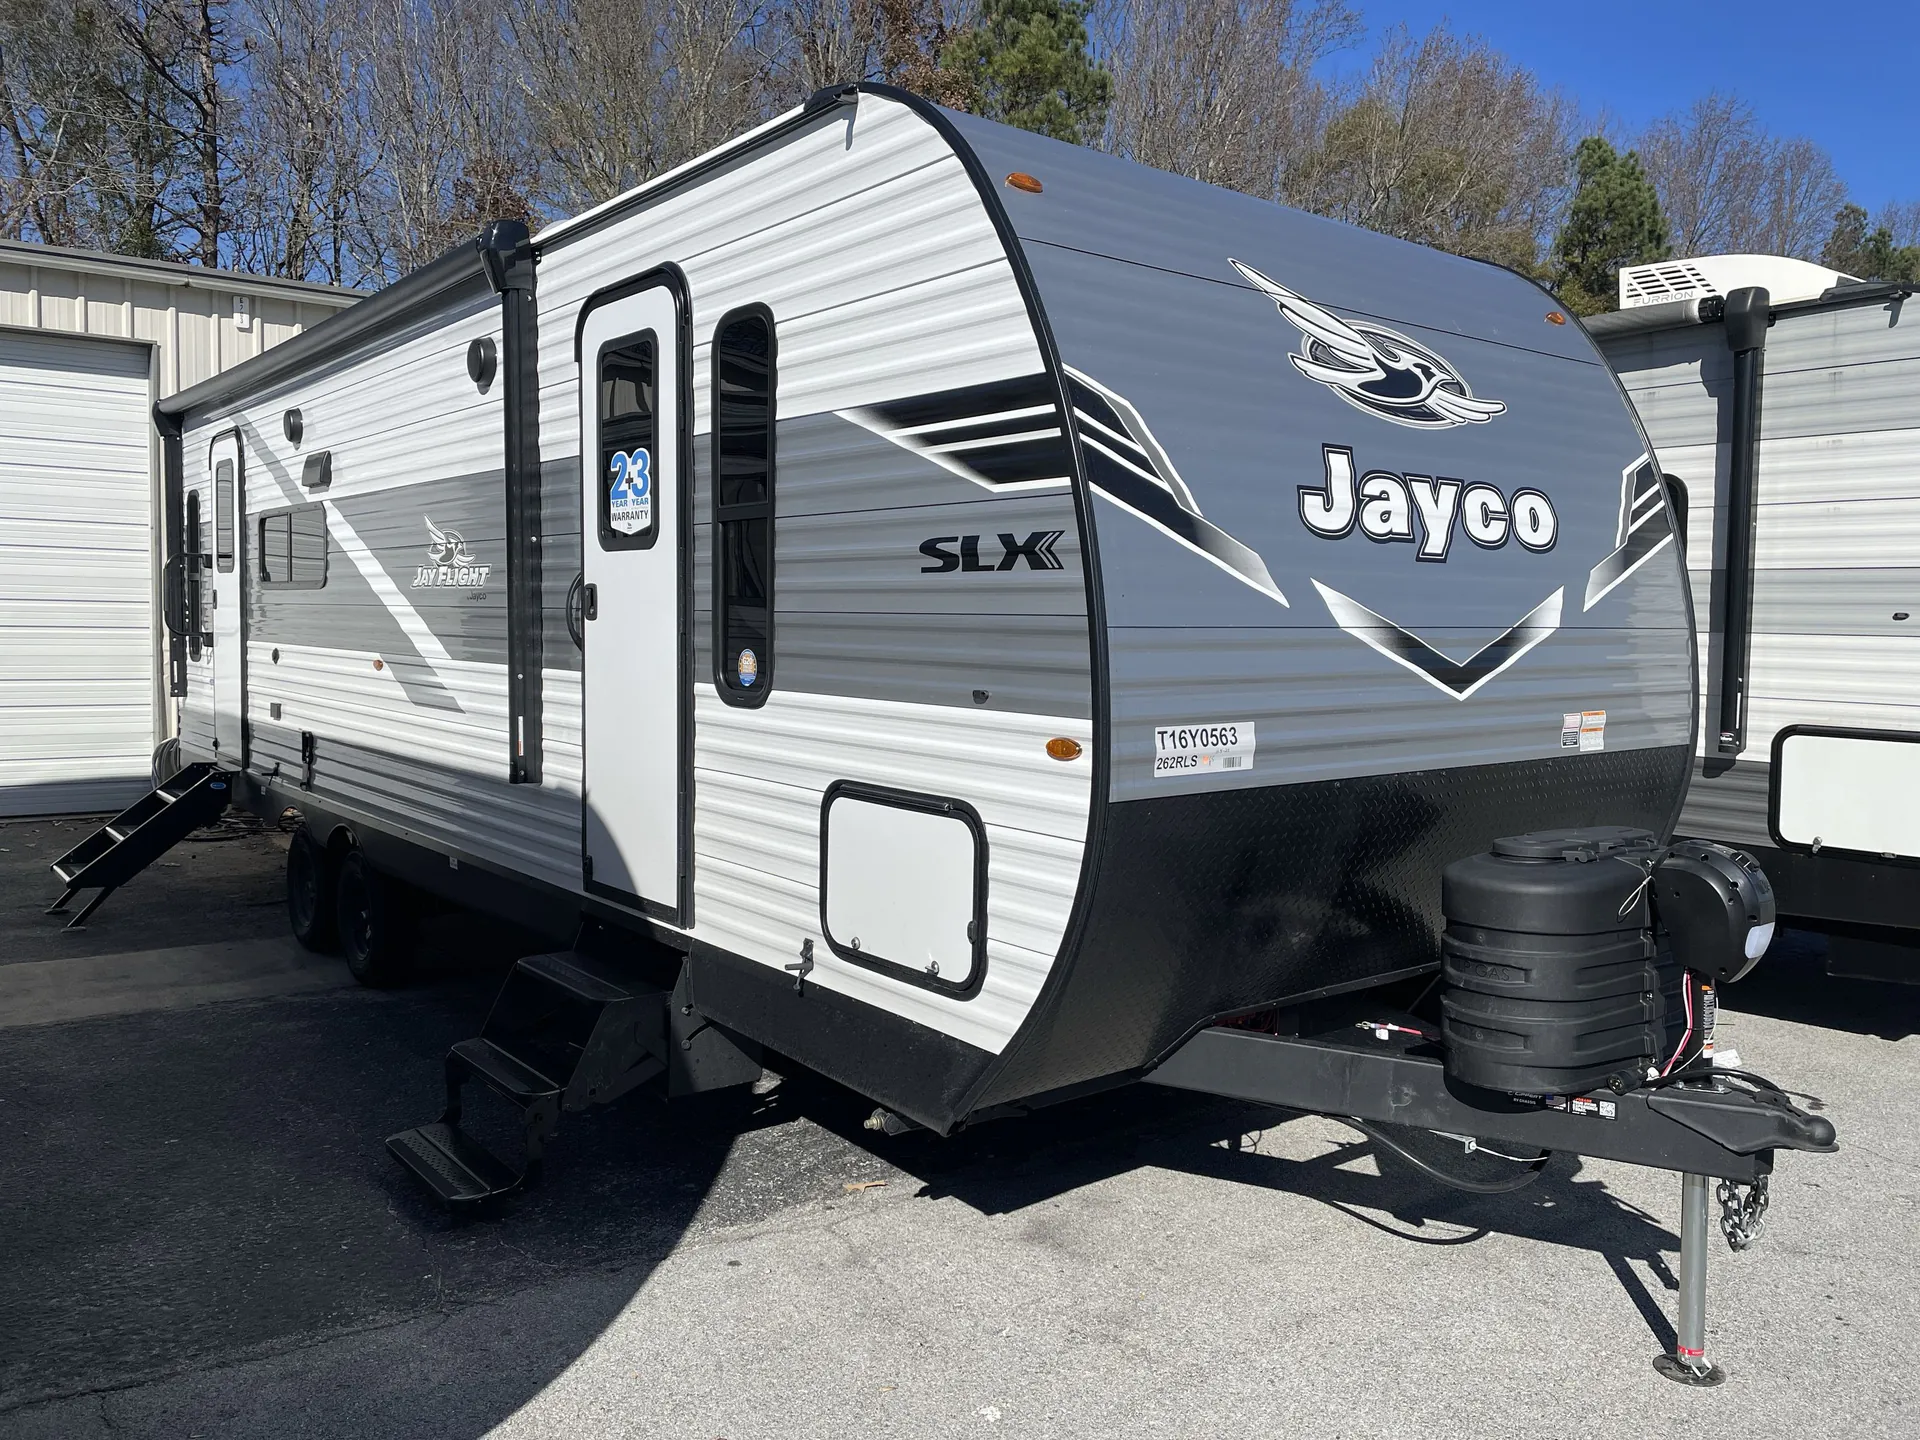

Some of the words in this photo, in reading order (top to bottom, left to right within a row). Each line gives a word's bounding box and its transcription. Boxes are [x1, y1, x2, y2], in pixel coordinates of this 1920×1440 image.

[1633, 291, 1694, 307] FURRION
[611, 499, 628, 508] YEAR
[631, 497, 649, 506] YEAR
[1298, 444, 1557, 563] Jayco
[611, 509, 649, 521] WARRANTY
[919, 530, 1066, 573] SLX
[411, 565, 438, 588] JAY
[436, 564, 491, 588] FLIGHT
[1157, 726, 1238, 750] T16Y0563
[1156, 754, 1198, 770] 262RLS
[1475, 963, 1510, 982] GAS
